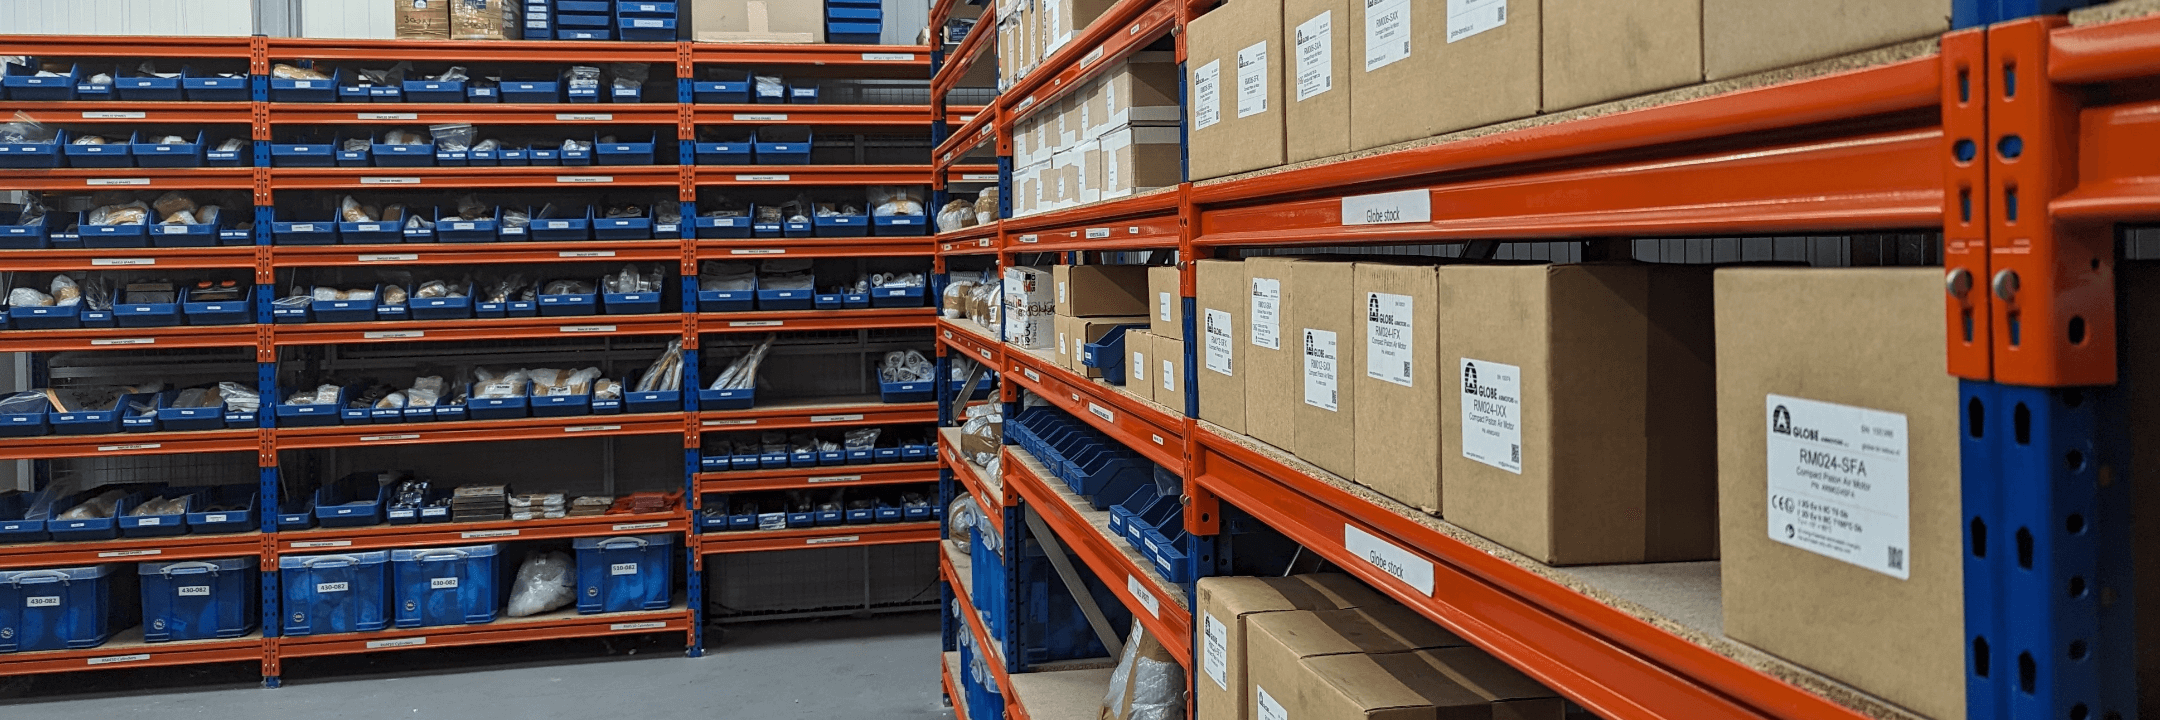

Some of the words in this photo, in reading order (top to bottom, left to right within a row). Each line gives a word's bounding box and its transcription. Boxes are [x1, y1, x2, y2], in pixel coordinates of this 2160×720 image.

[1367, 208, 1383, 223] Globe
[1384, 206, 1400, 222] stock
[1380, 313, 1393, 325] GLOBE
[1479, 385, 1497, 400] GLOBE
[1474, 399, 1507, 418] RM024-IXX
[1469, 412, 1484, 423] Compact
[1485, 416, 1496, 426] Piston
[1503, 420, 1514, 430] Motor
[1793, 426, 1819, 441] GLOBE
[1800, 448, 1867, 477] RM024-SFA
[1796, 466, 1820, 480] Compact
[1823, 472, 1841, 483] Piston
[1853, 478, 1871, 491] Motor
[612, 564, 635, 572] 510-082
[1370, 550, 1387, 571] Globe
[1388, 561, 1404, 579] stock
[182, 586, 207, 594] 430-082
[320, 583, 345, 591] 430-082
[433, 579, 456, 587] 430-082
[30, 597, 57, 605] 430-082
